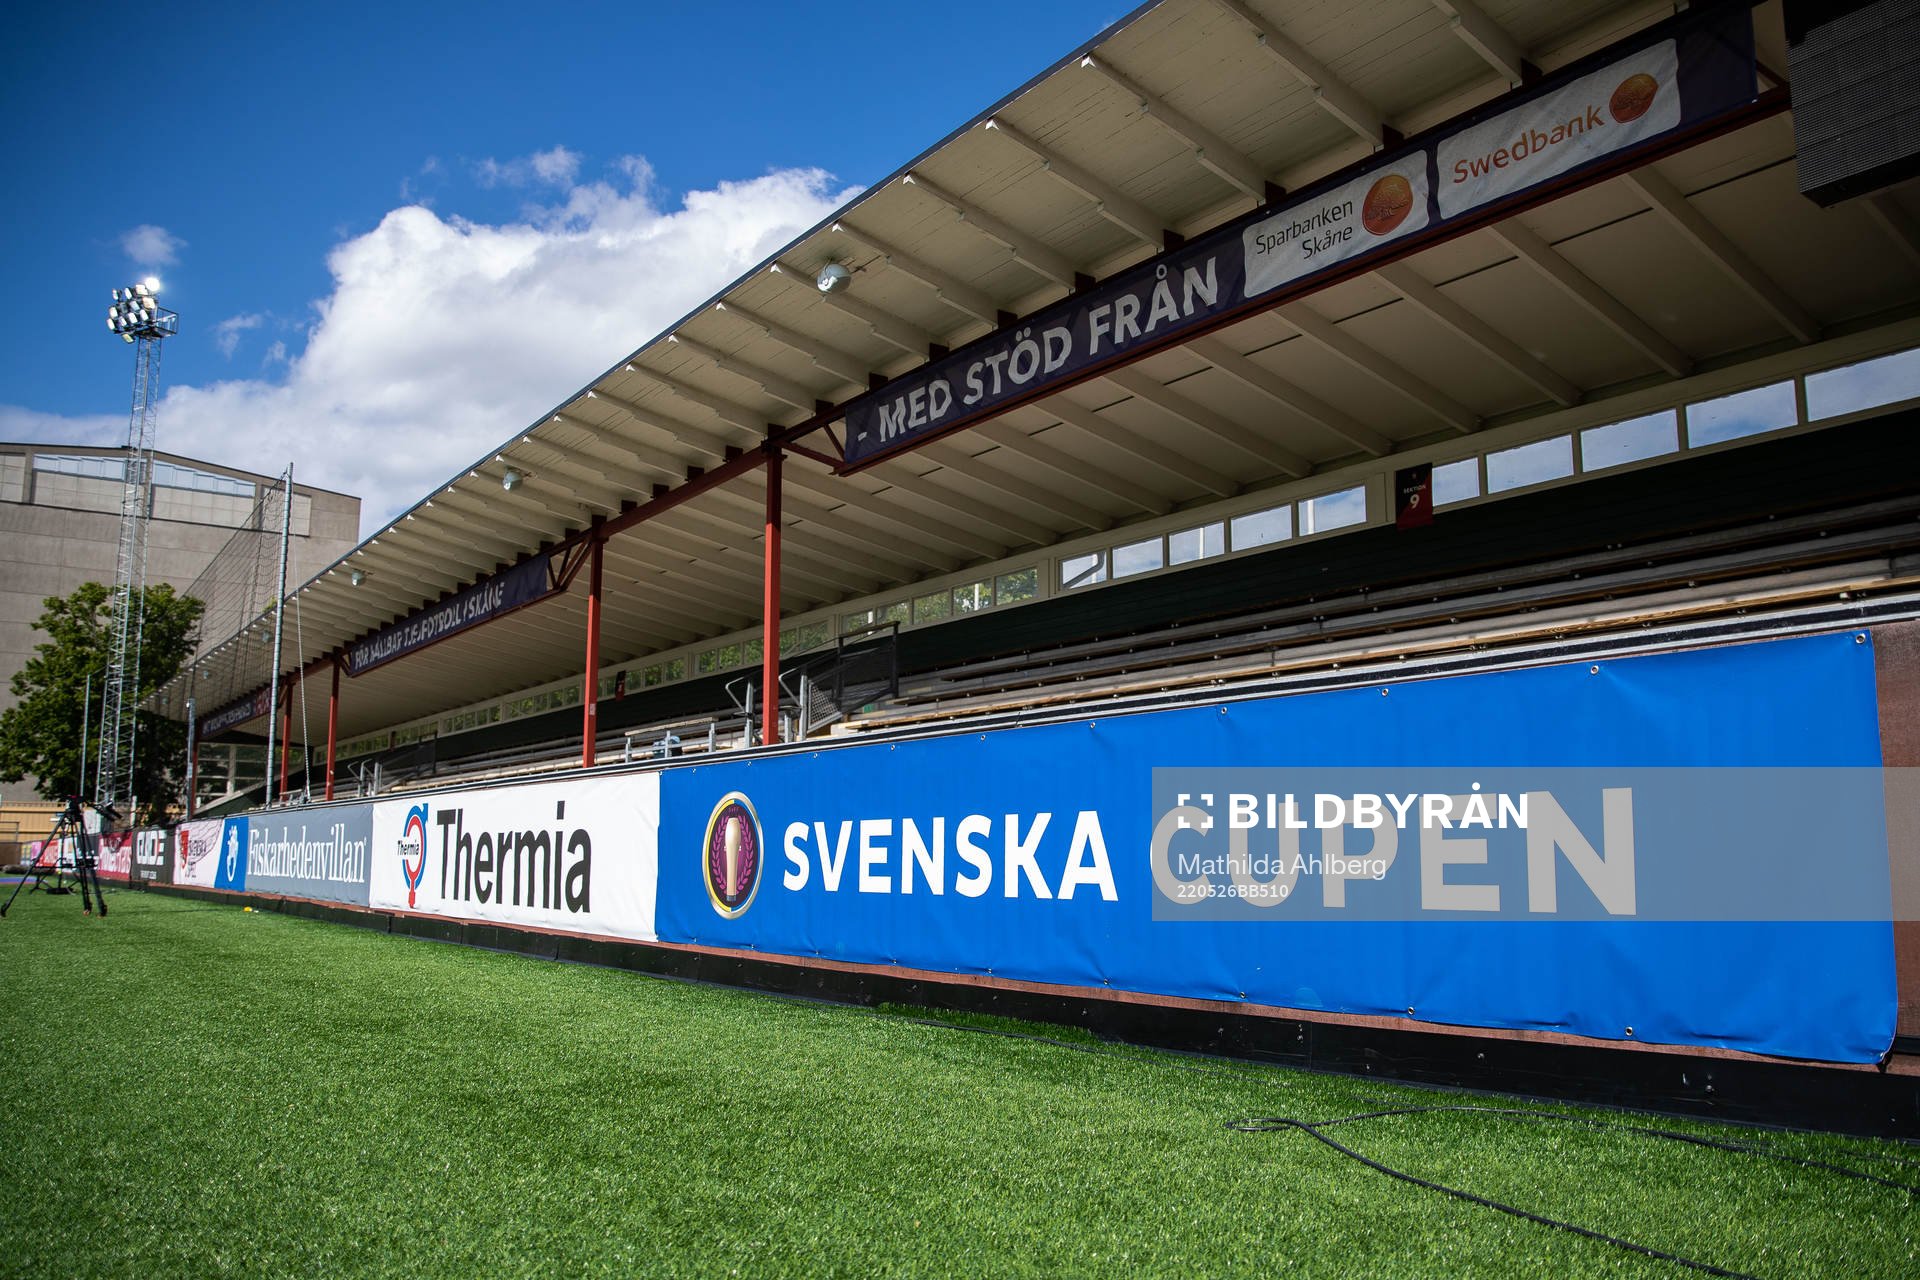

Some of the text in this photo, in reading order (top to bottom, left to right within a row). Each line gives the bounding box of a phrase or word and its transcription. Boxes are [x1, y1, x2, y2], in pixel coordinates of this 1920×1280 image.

[1452, 104, 1605, 184] Swedbank
[1256, 199, 1353, 256] Sparbanken
[1302, 224, 1353, 259] Skåne
[878, 379, 952, 443] MED
[963, 326, 1073, 405] STÖD
[1088, 256, 1218, 356] FRÅN
[1410, 494, 1420, 509] 9
[355, 644, 369, 670] FÖR
[247, 823, 366, 884] Fiskarhedenvillan
[397, 839, 420, 856] Thermia
[437, 800, 592, 914] Thermia
[783, 787, 1637, 916] SVENSKA CUPEN
